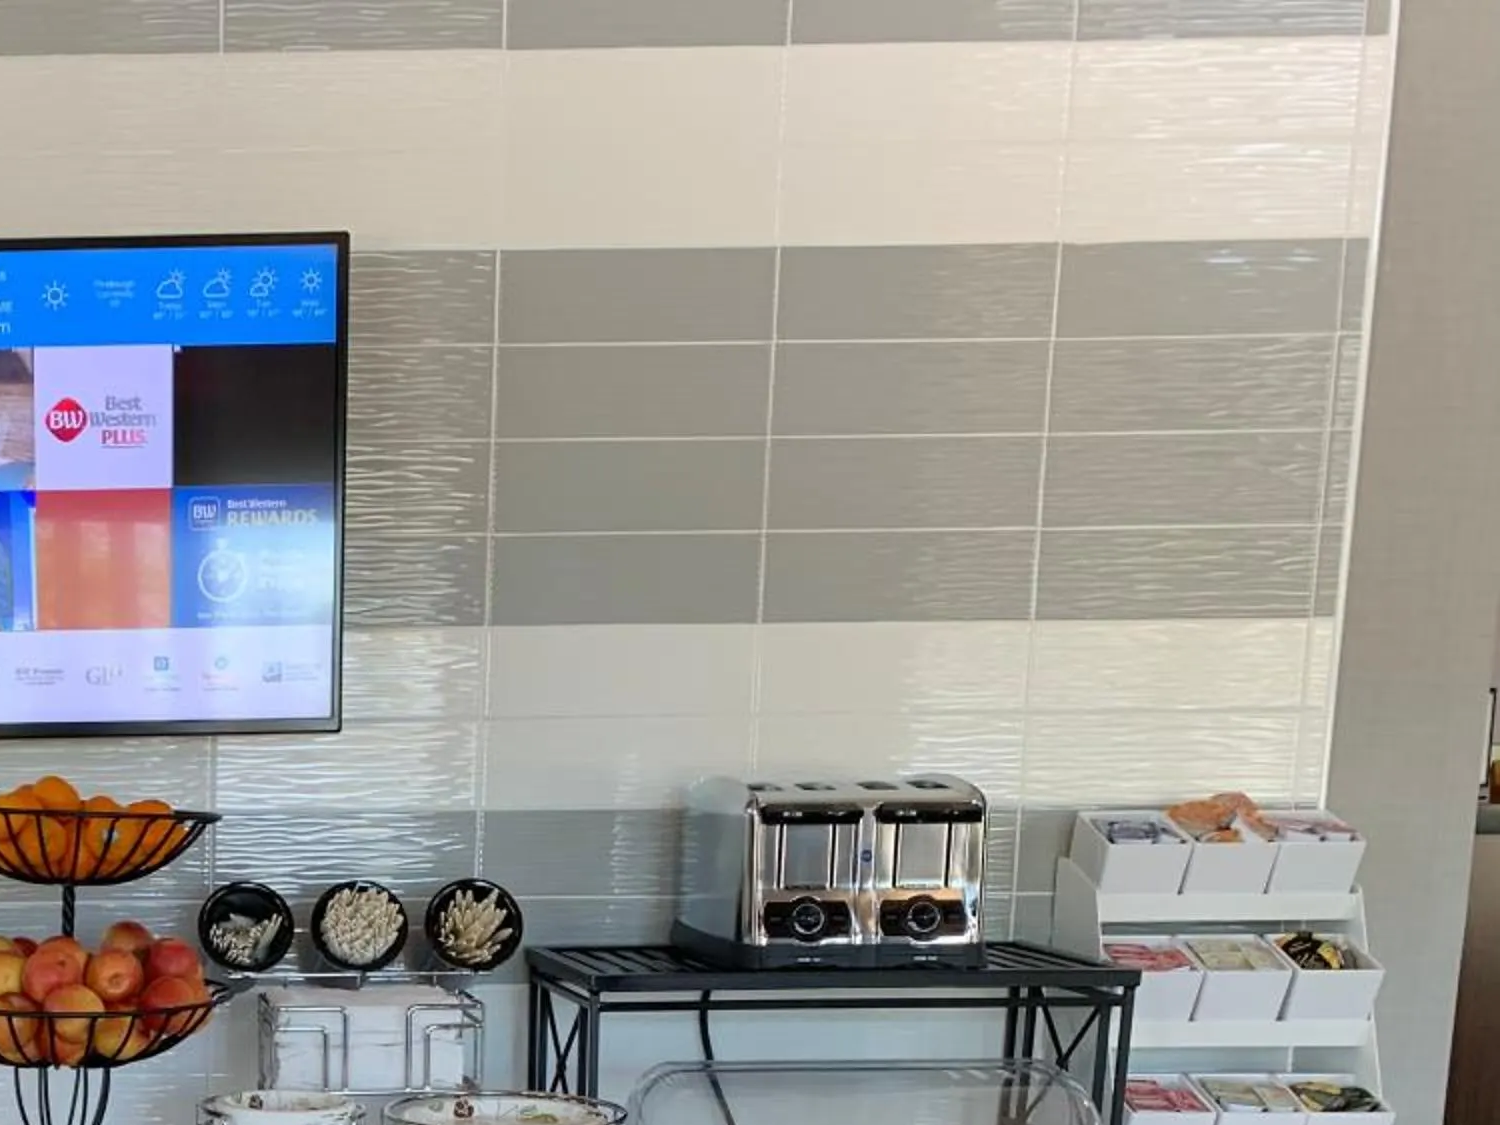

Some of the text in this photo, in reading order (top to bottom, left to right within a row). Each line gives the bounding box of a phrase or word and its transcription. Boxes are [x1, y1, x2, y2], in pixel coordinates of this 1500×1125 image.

[105, 397, 141, 411] Best
[50, 411, 84, 429] BW
[90, 412, 156, 427] Western
[102, 429, 147, 445] PLUS
[227, 509, 318, 526] REWARDS
